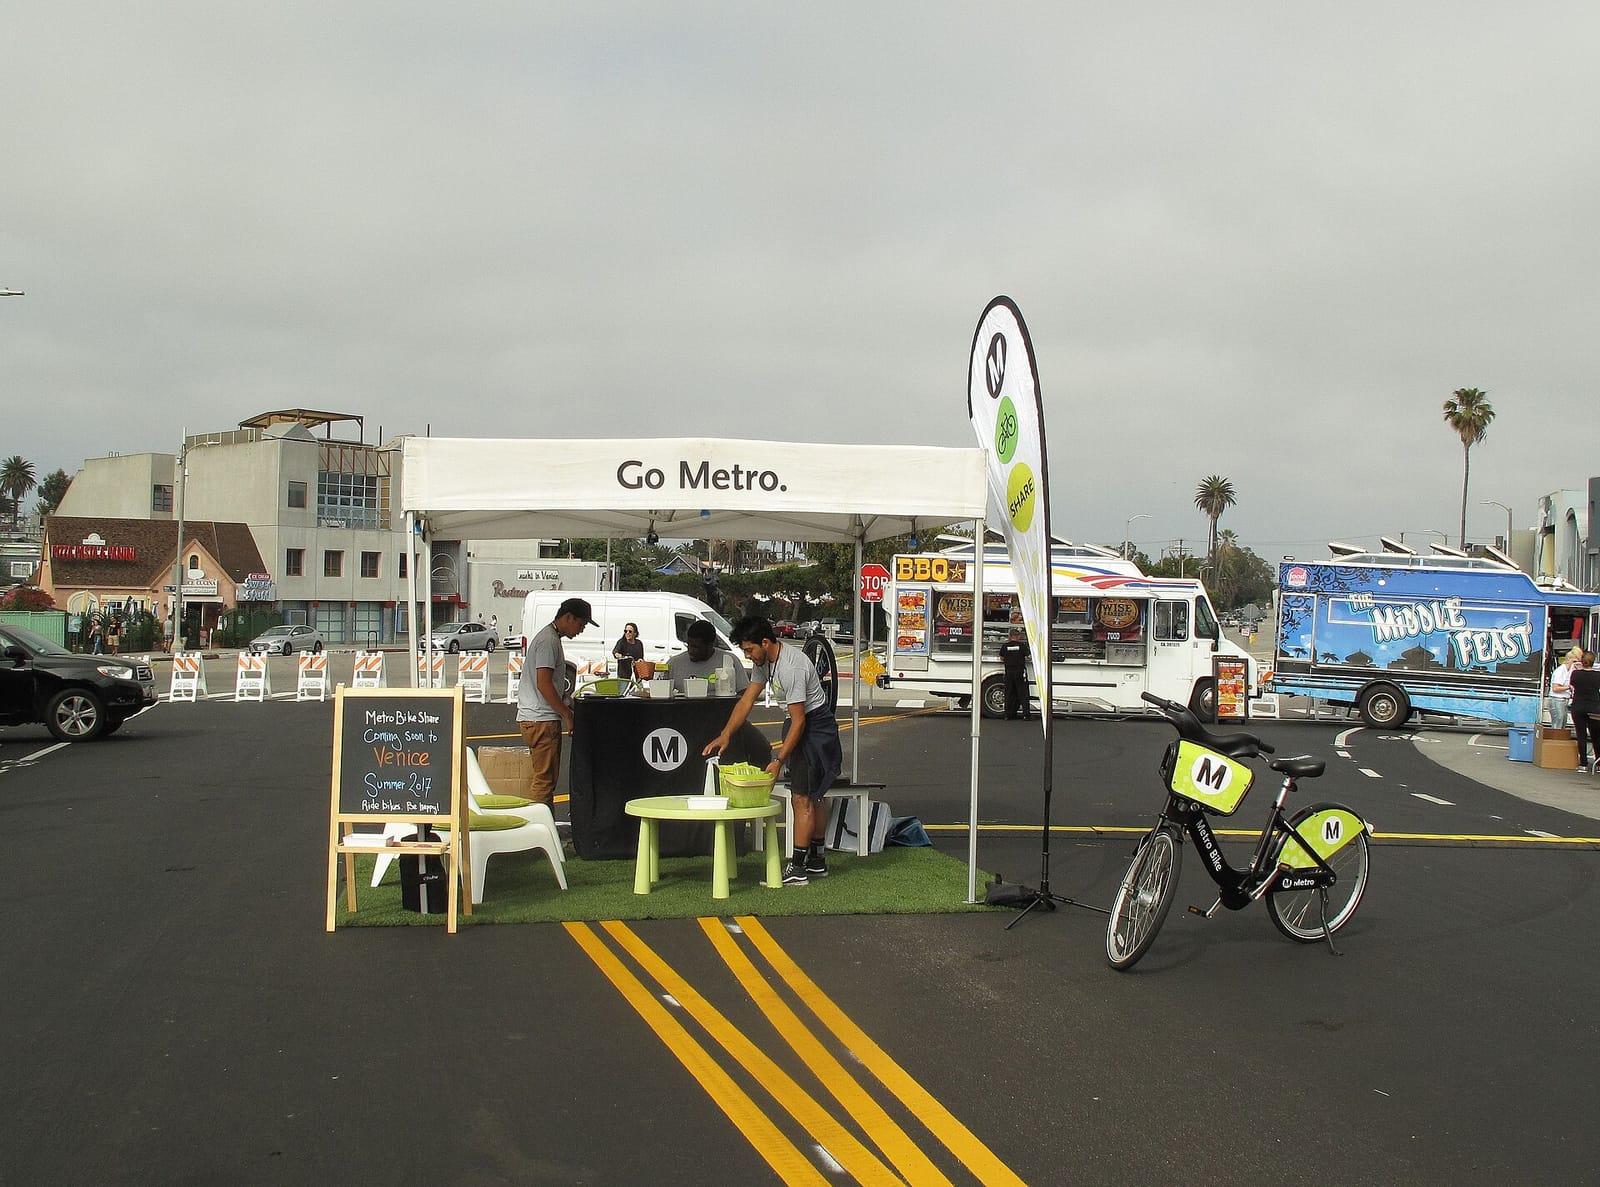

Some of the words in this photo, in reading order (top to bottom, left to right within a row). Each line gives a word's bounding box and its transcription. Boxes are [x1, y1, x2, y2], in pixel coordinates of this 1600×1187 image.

[617, 460, 665, 490] Go
[679, 460, 787, 492] Metro.
[1010, 478, 1034, 518] SHARE
[108, 546, 136, 560] PANINI
[897, 558, 948, 582] BBQ
[246, 579, 272, 589] Sweet
[246, 589, 271, 600] Stuff
[1102, 604, 1132, 613] WISE
[1349, 593, 1373, 612] THE
[1454, 623, 1533, 667] FEAST
[365, 710, 394, 725] Metro
[395, 710, 417, 725] Bike
[418, 711, 440, 724] Share
[363, 728, 402, 751] Coming
[428, 730, 438, 743] to
[373, 745, 430, 768] Venice
[364, 772, 405, 798] Summer
[408, 772, 432, 798] 2017
[361, 799, 380, 812] Ride
[406, 801, 417, 812] Be
[1195, 819, 1212, 850] Metro
[1209, 849, 1222, 872] Bike
[1293, 878, 1315, 887] Metro
